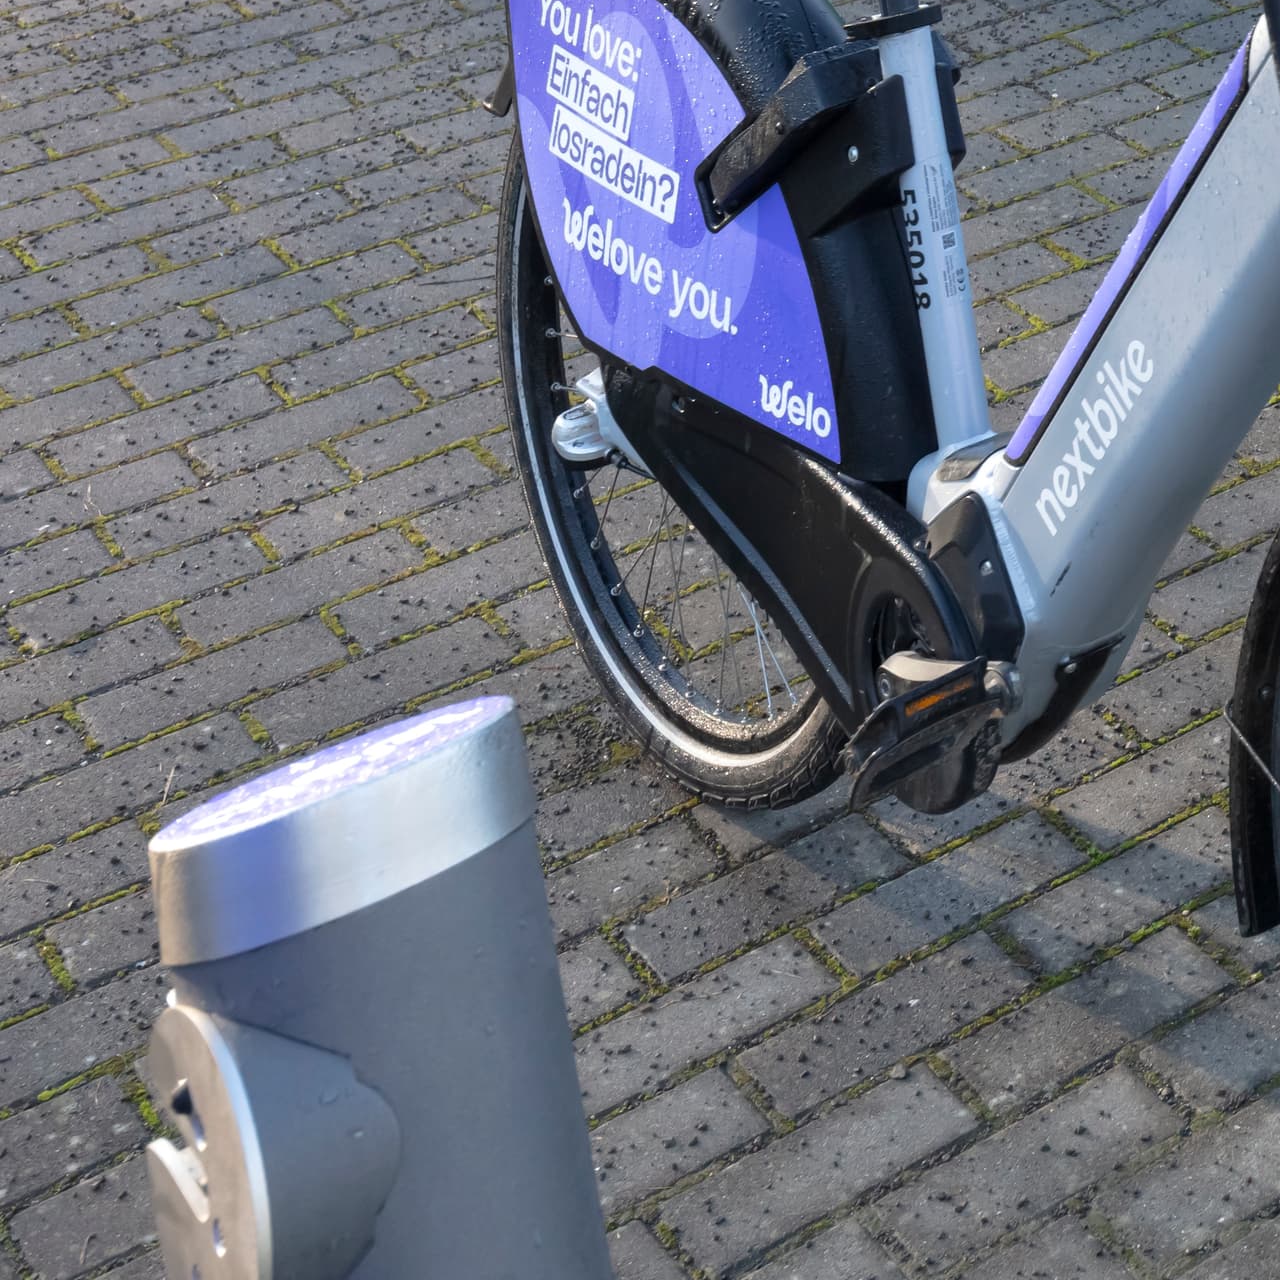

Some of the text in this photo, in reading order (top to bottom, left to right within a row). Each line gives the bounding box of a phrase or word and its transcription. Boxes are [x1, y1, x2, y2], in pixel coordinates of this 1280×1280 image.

[550, 52, 630, 134] Einfach
[583, 8, 643, 83] love:
[552, 110, 676, 214] losradeln?
[563, 197, 738, 336] Welove you.
[901, 189, 931, 310] 535018
[759, 374, 831, 438] Welo
[1035, 339, 1154, 537] nextbike
